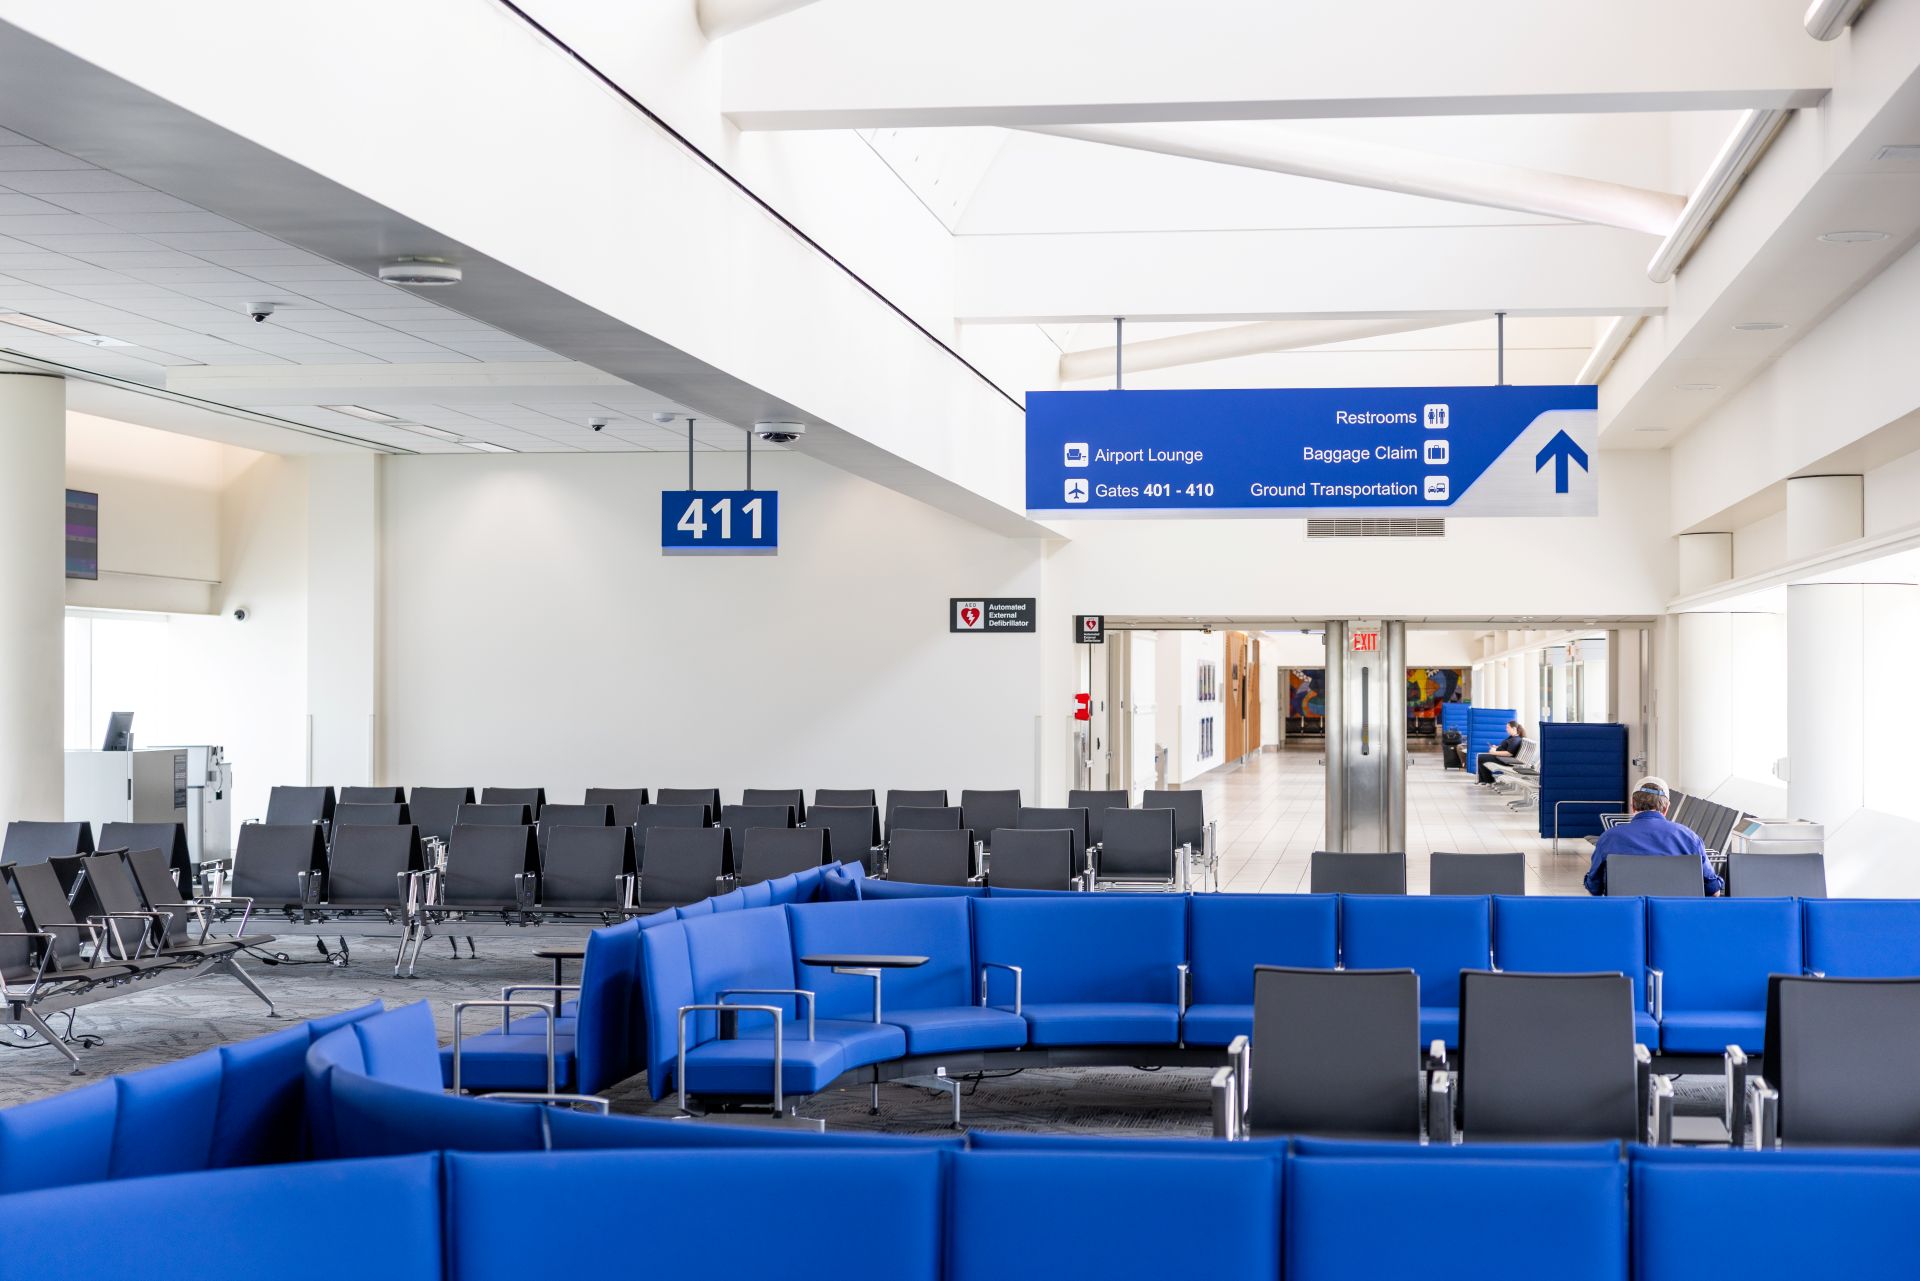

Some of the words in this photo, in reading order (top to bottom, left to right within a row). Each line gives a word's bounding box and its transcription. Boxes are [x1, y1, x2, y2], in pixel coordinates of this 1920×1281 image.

[1336, 410, 1417, 424] Restrooms
[1094, 448, 1144, 464] Airport
[1148, 448, 1203, 464] Lounge
[1303, 446, 1370, 463] Baggage
[1375, 446, 1418, 460] Claim
[1095, 484, 1139, 497] Gates
[1143, 483, 1171, 497] 401
[1185, 483, 1214, 497] 410
[1250, 482, 1306, 497] Ground
[1310, 482, 1418, 498] Transportation
[677, 498, 762, 539] 411
[989, 603, 1026, 611] Automated
[1353, 633, 1377, 651] EXIT
